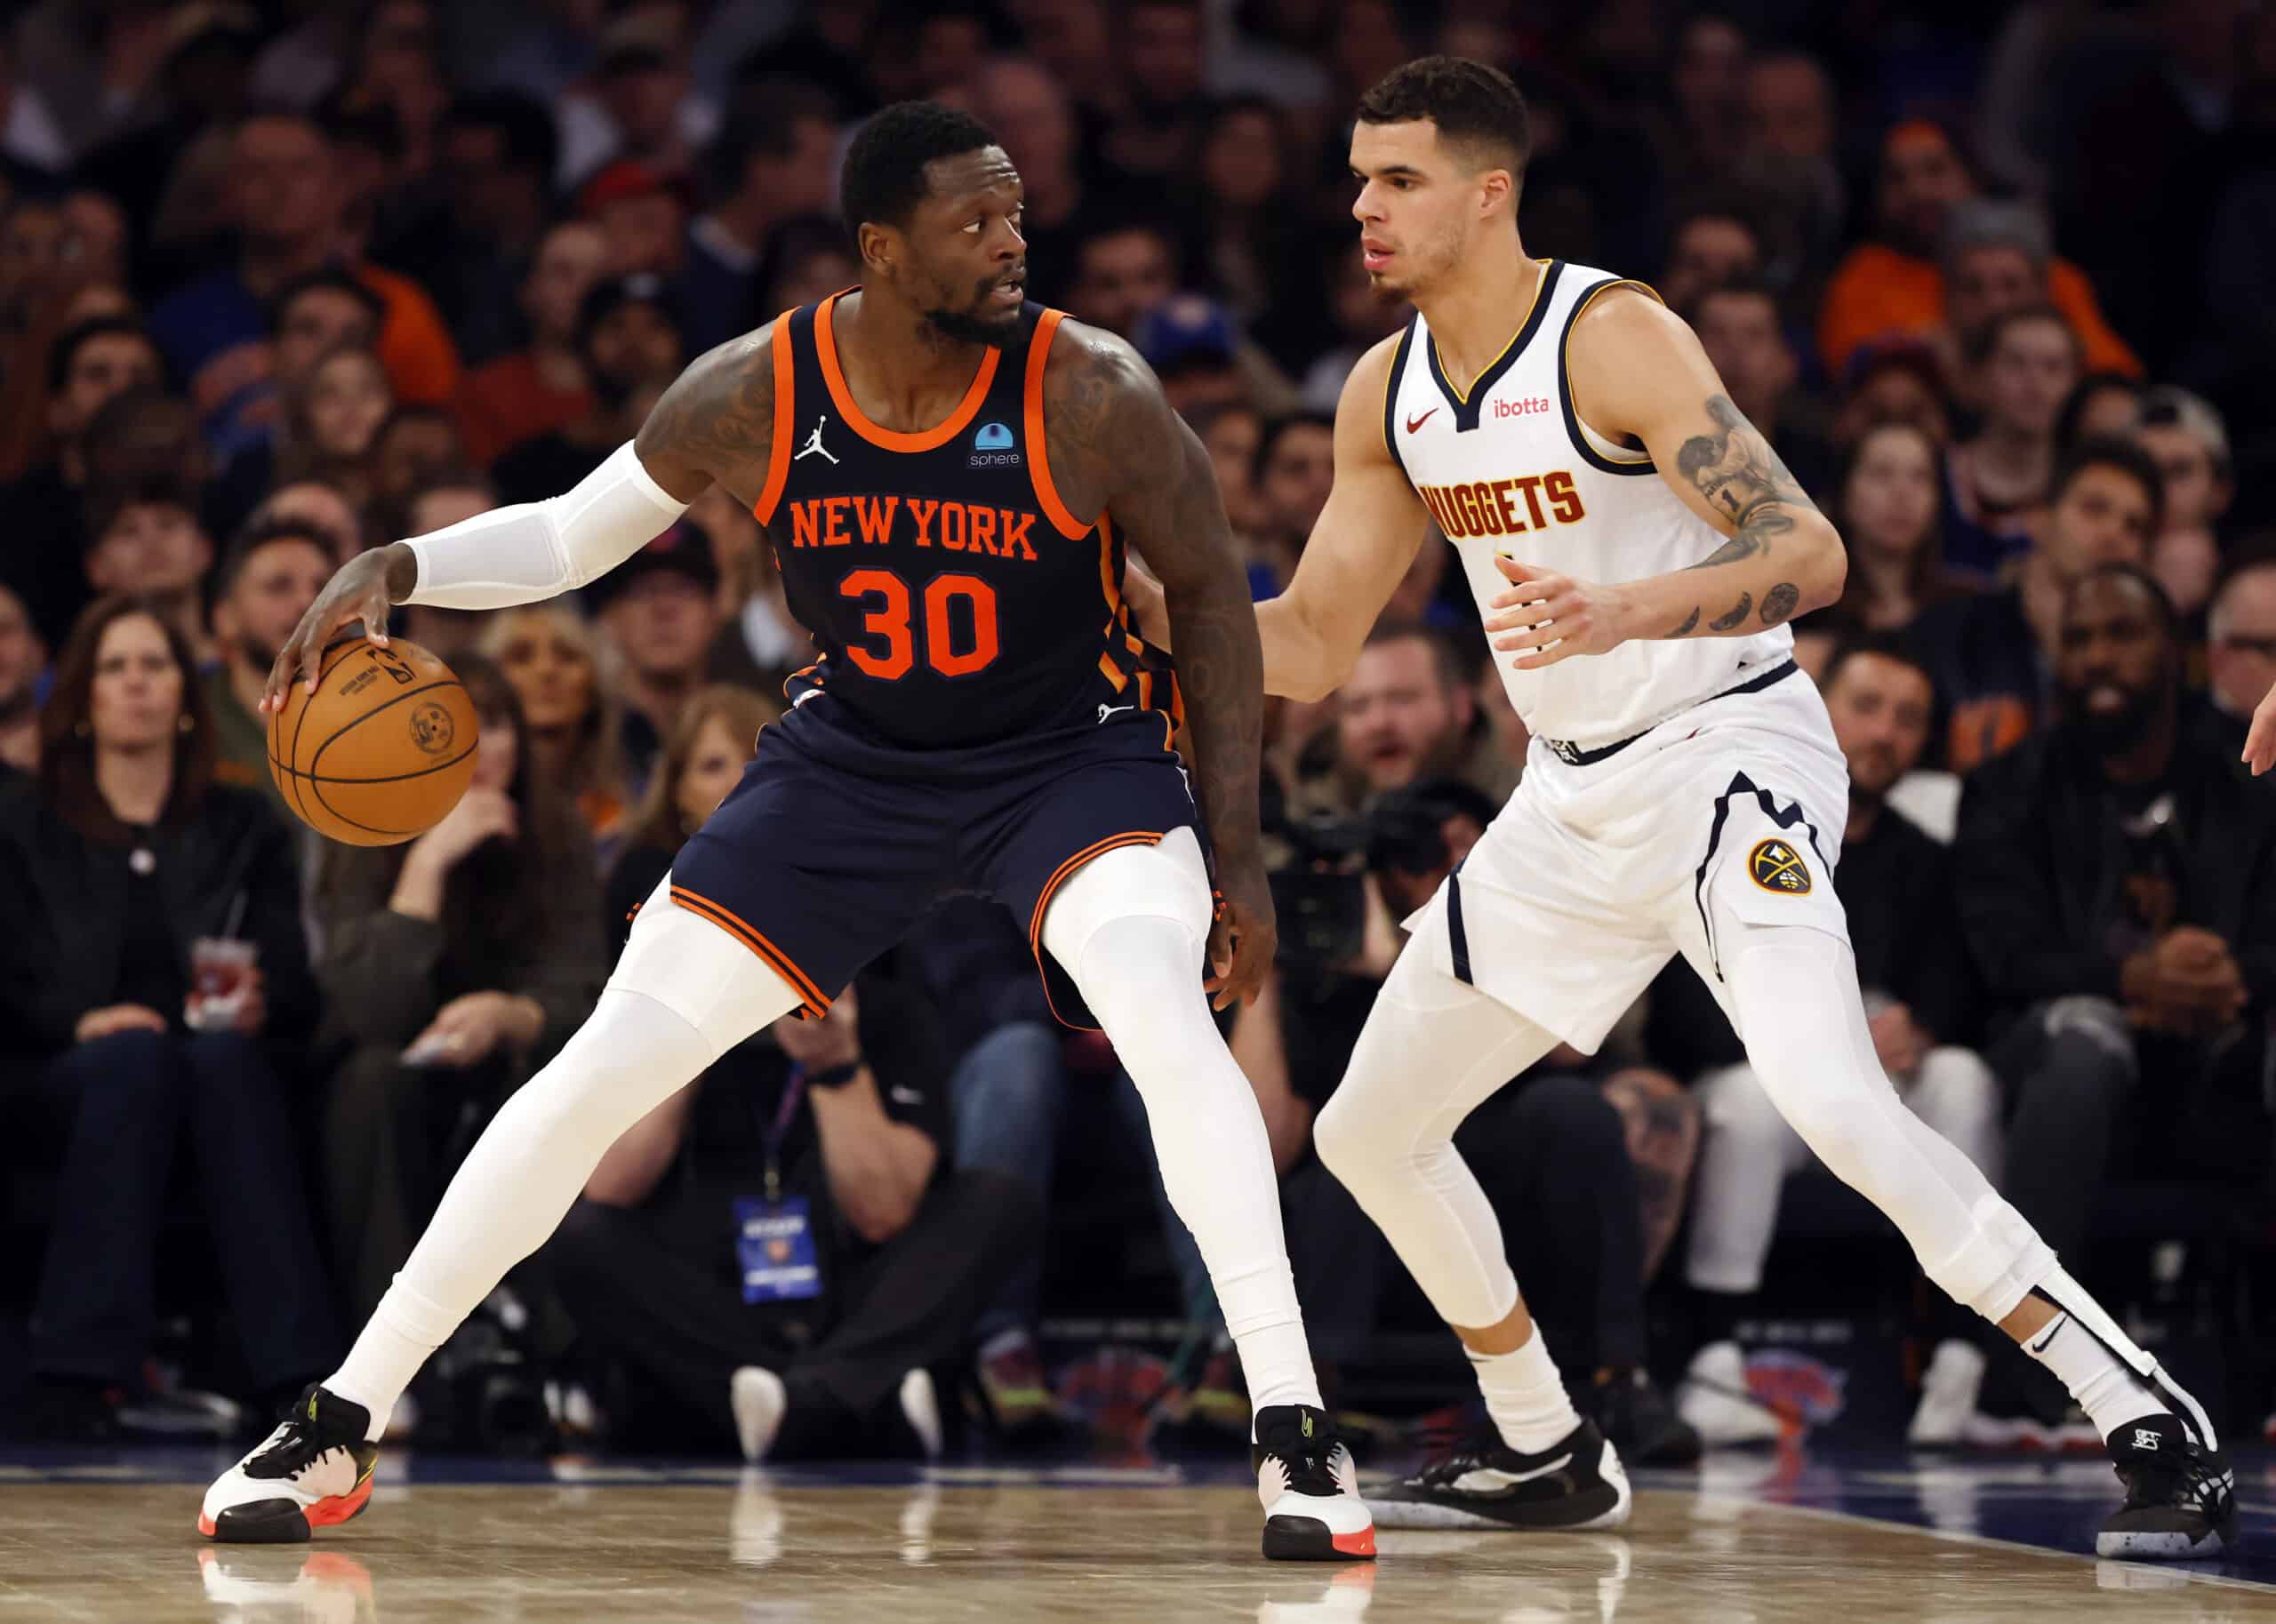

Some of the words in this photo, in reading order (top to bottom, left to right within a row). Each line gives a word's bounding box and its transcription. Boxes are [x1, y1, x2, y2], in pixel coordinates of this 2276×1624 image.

[1494, 397, 1549, 419] ibotta
[970, 453, 1019, 468] sphere
[789, 496, 899, 548] NEW
[906, 498, 1038, 561] YORK
[1418, 470, 1586, 539] NUGGETS
[839, 569, 998, 681] 30
